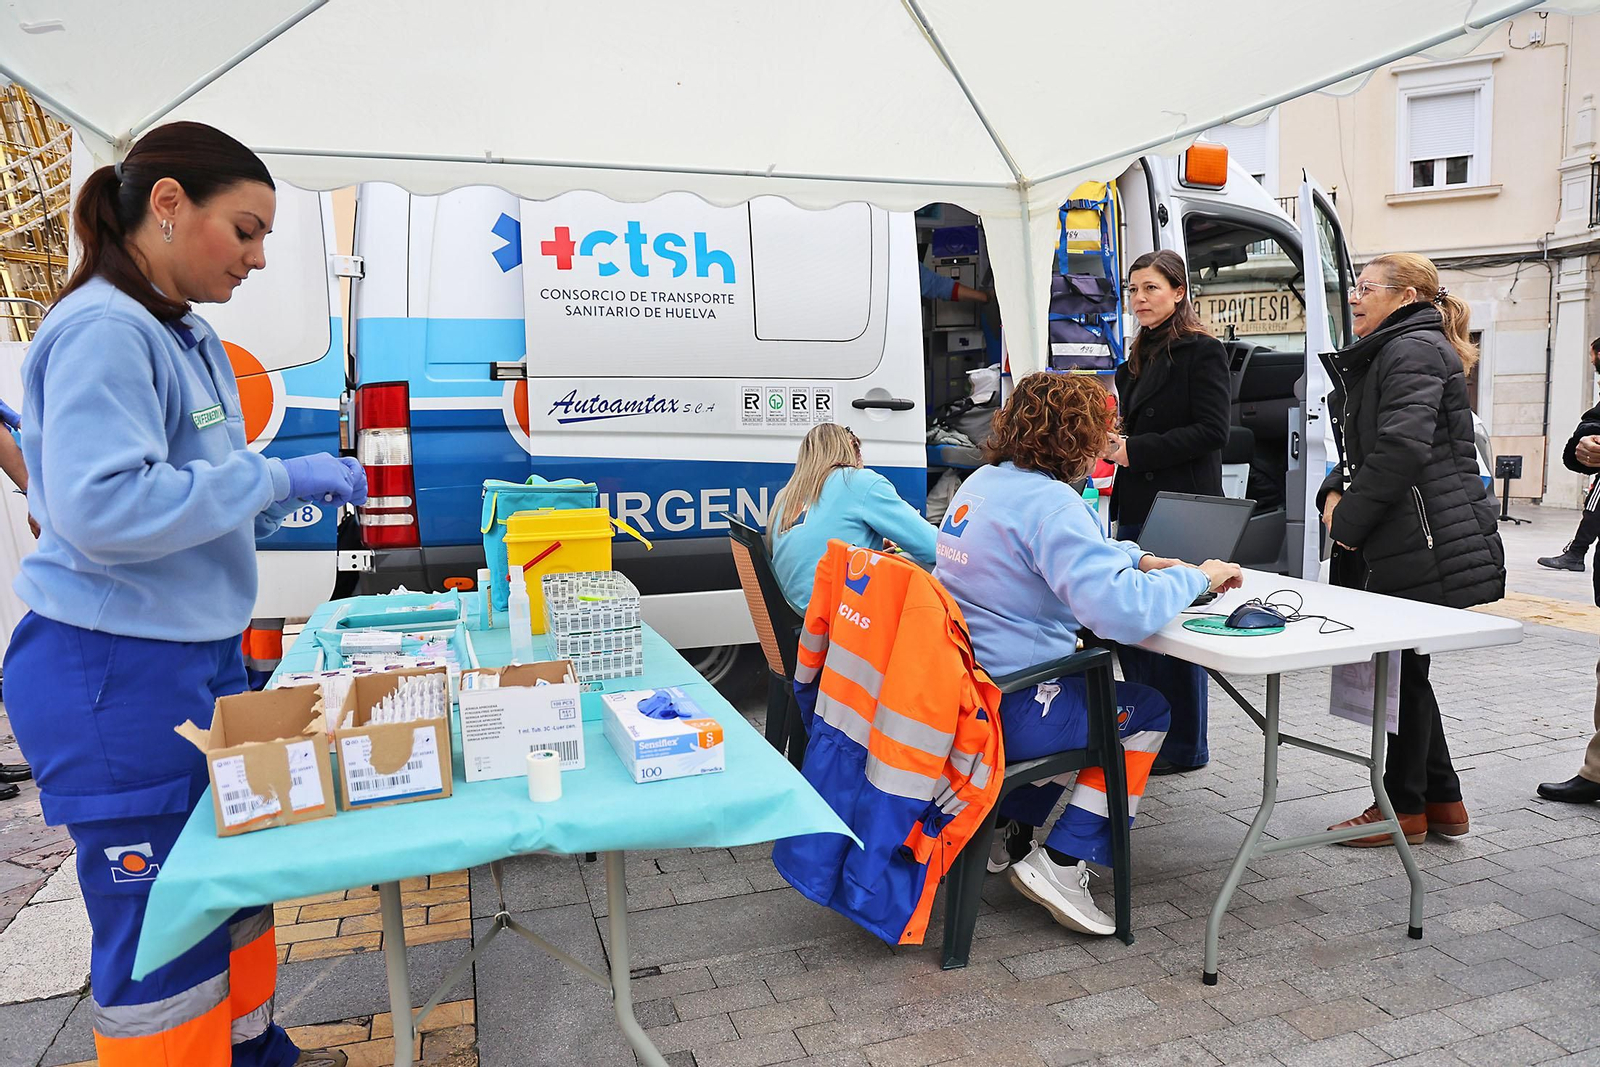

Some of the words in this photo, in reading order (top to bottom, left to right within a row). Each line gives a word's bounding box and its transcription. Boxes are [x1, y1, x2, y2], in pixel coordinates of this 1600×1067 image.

[579, 221, 736, 283] ctsh
[540, 288, 626, 301] CONSORCIO
[630, 291, 647, 302] DE
[651, 291, 735, 304] TRANSPORTE
[565, 305, 640, 317] SANITARIO
[644, 307, 661, 318] DE
[665, 307, 717, 319] HUELVA
[1208, 295, 1289, 324] TRAVIESA
[548, 389, 679, 416] Autoamtax
[293, 506, 313, 523] 18
[638, 738, 678, 750] Sensiflex
[706, 732, 714, 742] S
[641, 766, 662, 779] 100
